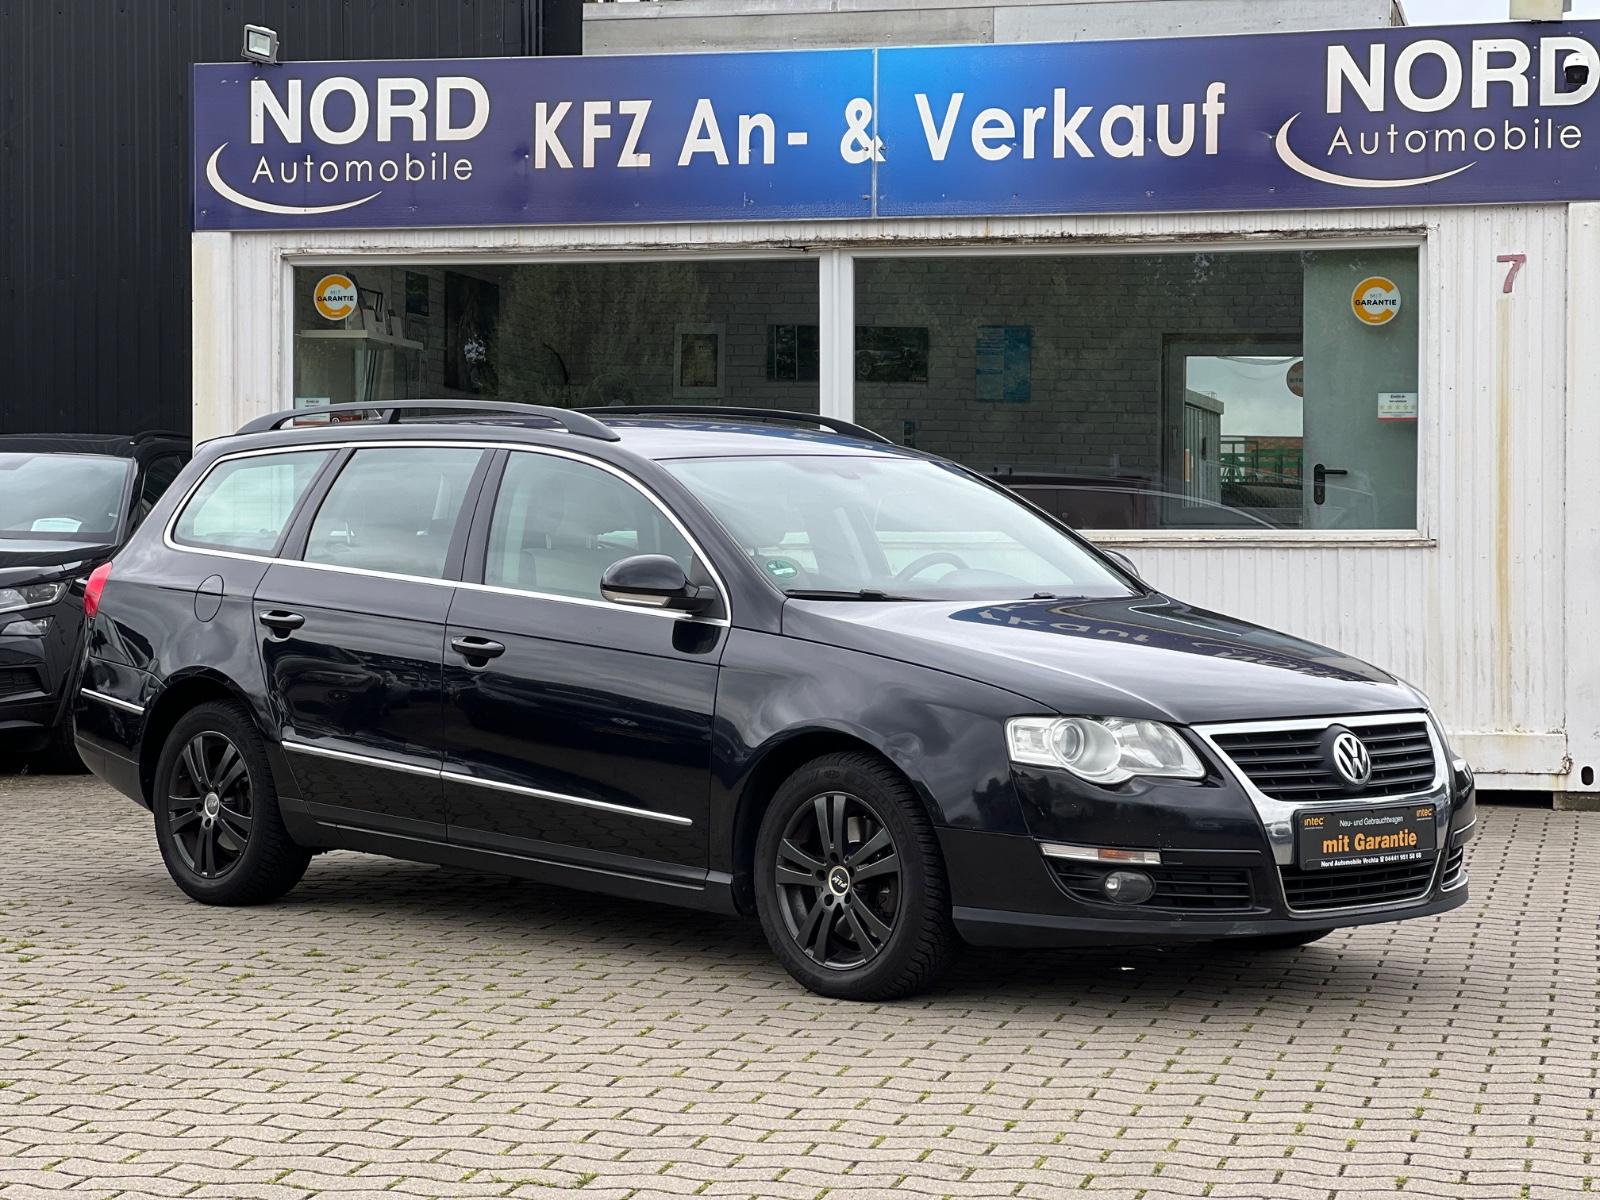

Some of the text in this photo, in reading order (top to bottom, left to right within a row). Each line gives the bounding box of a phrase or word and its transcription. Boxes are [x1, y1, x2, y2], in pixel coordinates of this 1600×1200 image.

[1326, 37, 1600, 114] NORD
[250, 76, 490, 145] NORD
[534, 81, 1226, 169] KFZ An- & Verkauf
[1327, 118, 1583, 156] Automobile
[251, 151, 474, 184] Automobile
[1496, 253, 1527, 293] 7
[1304, 817, 1324, 826] intec
[1339, 816, 1404, 827] Neu- und Gebrauchtwagen
[1322, 828, 1417, 853] mit Garantie
[1334, 858, 1362, 866] Automobile
